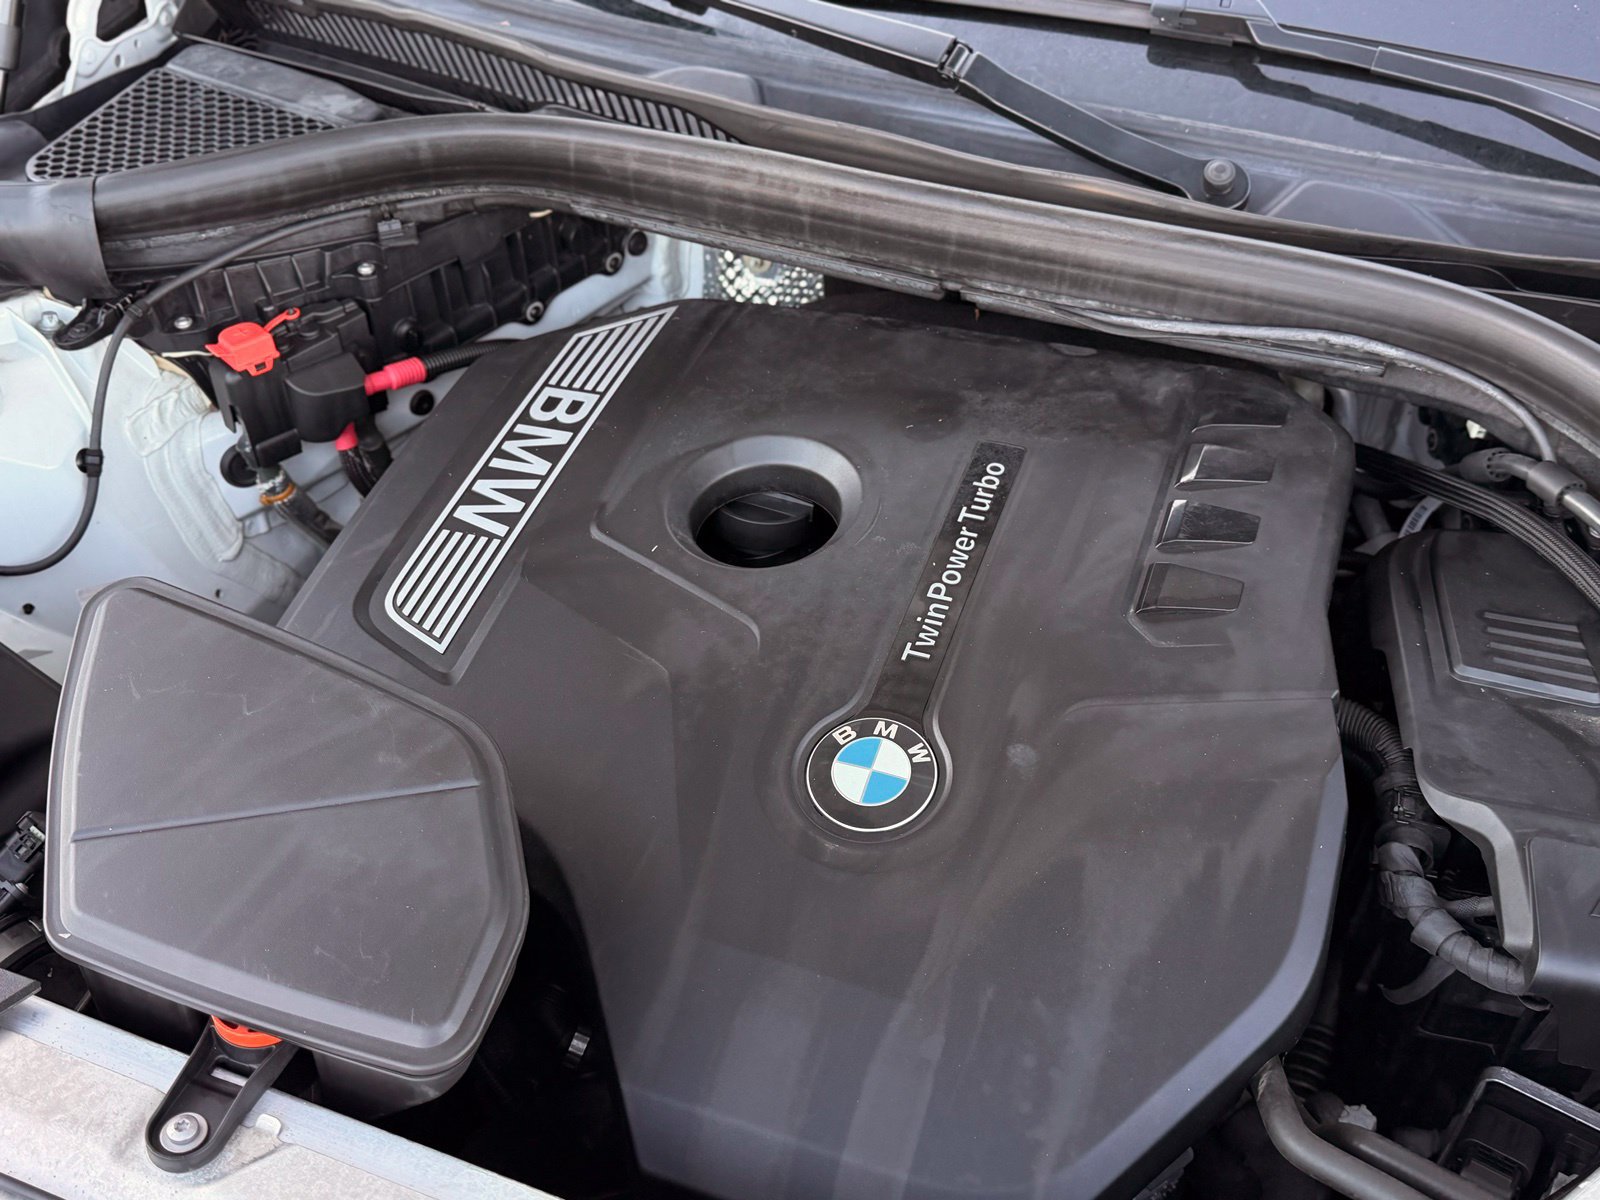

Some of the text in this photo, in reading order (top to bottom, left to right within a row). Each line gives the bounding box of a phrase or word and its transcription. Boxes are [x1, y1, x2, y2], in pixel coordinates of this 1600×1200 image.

[452, 386, 601, 538] BMW
[901, 462, 1006, 661] TwinPower Turbo
[831, 720, 932, 764] BMW
